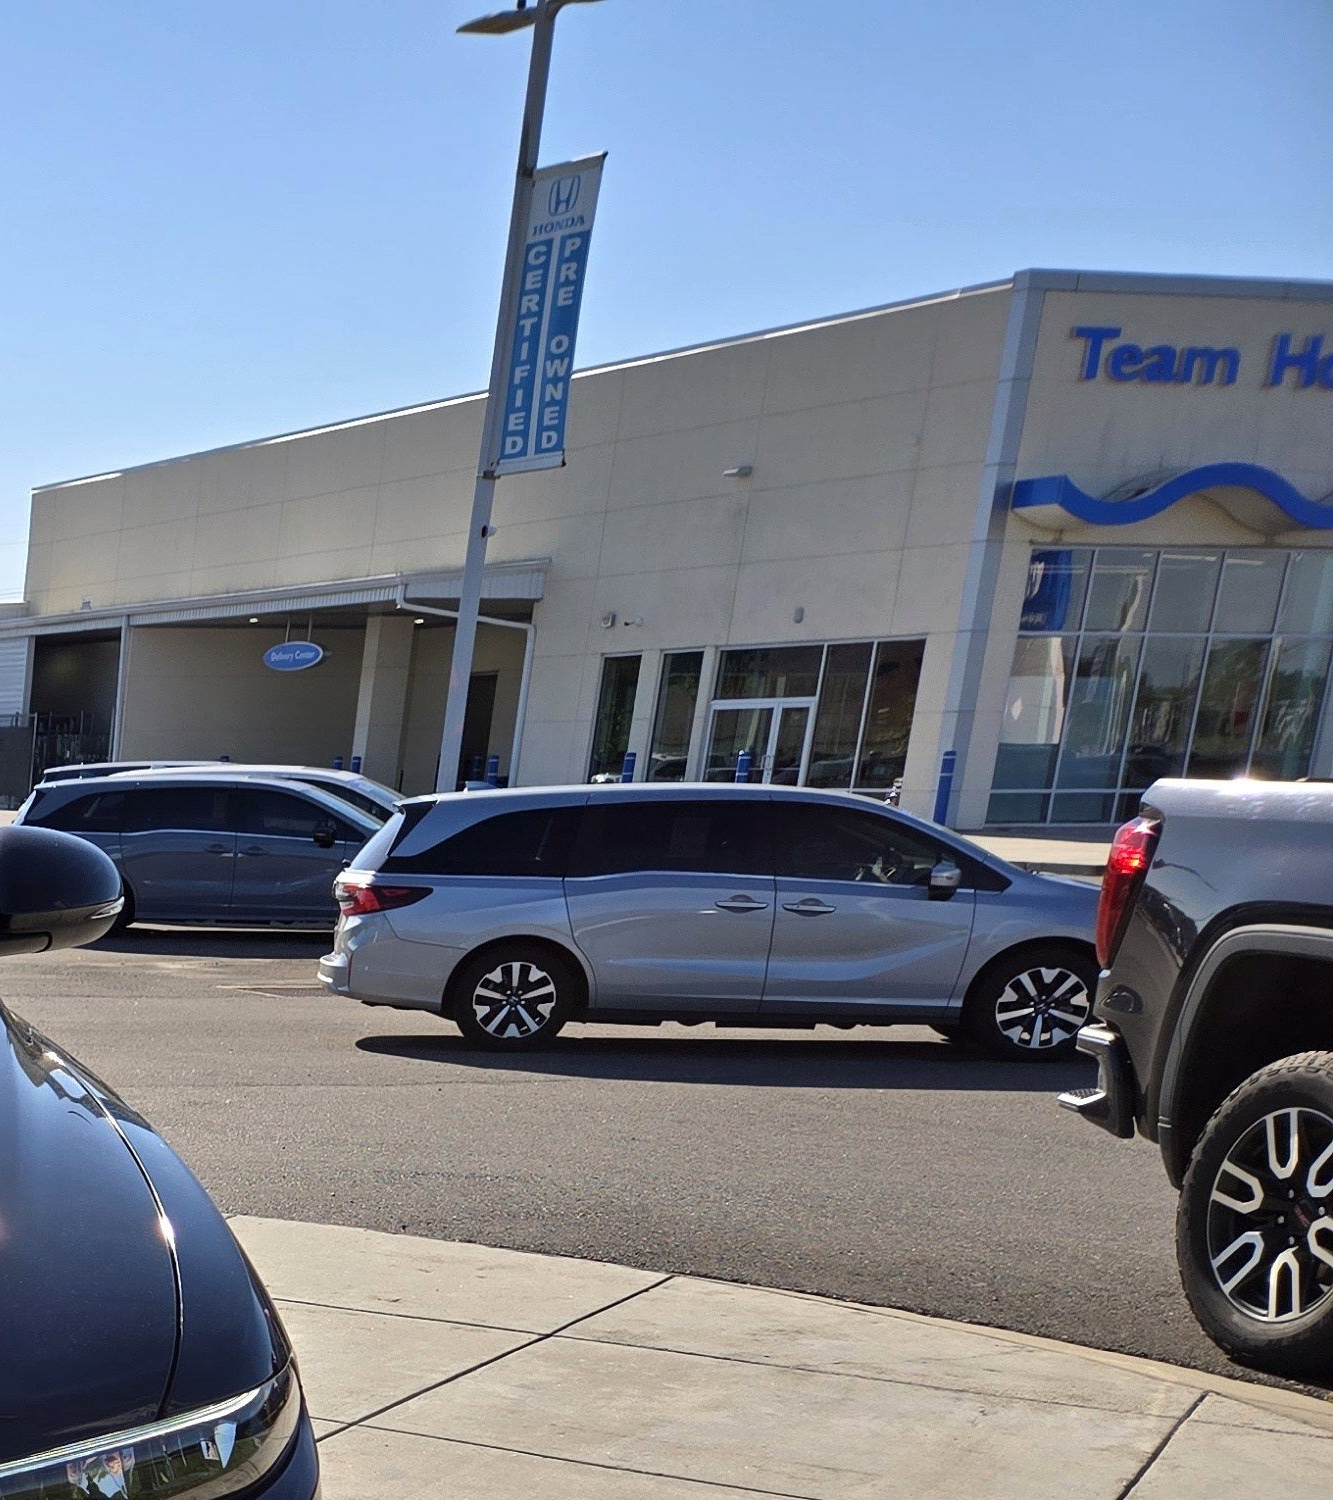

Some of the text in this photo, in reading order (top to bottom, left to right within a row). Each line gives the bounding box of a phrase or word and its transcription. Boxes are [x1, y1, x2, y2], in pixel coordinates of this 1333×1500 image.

[533, 215, 585, 235] HONDA
[505, 245, 548, 456] CERTIFIED
[540, 237, 582, 450] PRE OWNED
[1072, 326, 1241, 386] Team
